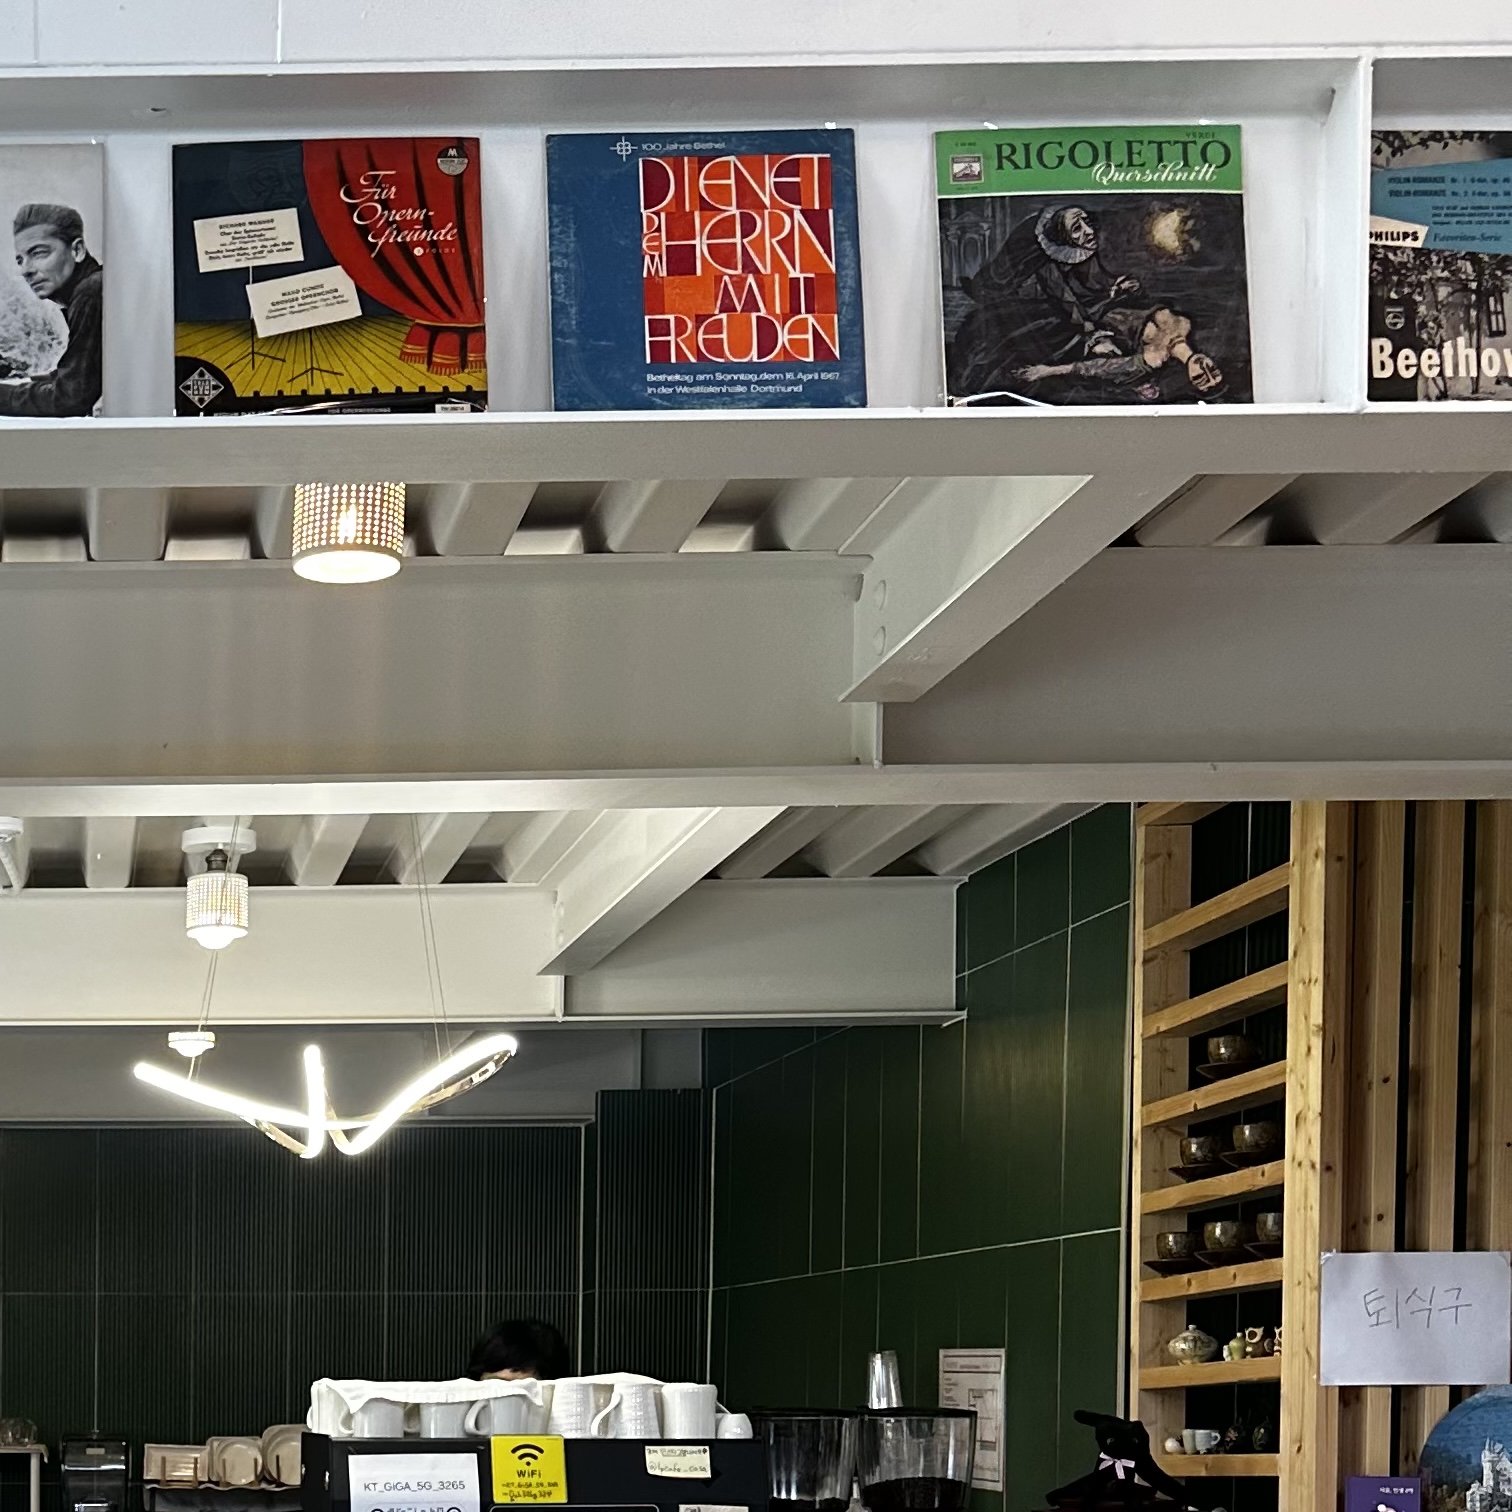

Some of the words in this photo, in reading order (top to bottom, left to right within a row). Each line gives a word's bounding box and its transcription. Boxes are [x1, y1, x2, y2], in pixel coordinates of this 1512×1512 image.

[642, 143, 662, 151] 100
[663, 142, 692, 151] Jahre
[693, 142, 726, 150] Bethel
[995, 139, 1232, 171] RIGOLETTO
[340, 170, 397, 203] Für
[639, 153, 831, 213] DIENET
[1091, 161, 1217, 186] Querschnitt
[353, 202, 434, 228] Opern-
[642, 212, 661, 277] DEM
[660, 208, 837, 277] HERRN
[714, 273, 815, 315] MIT
[644, 313, 841, 364] FREUDEN
[750, 384, 803, 393] Dortmund
[796, 372, 819, 382] April
[1362, 1286, 1473, 1330] 퇴식구
